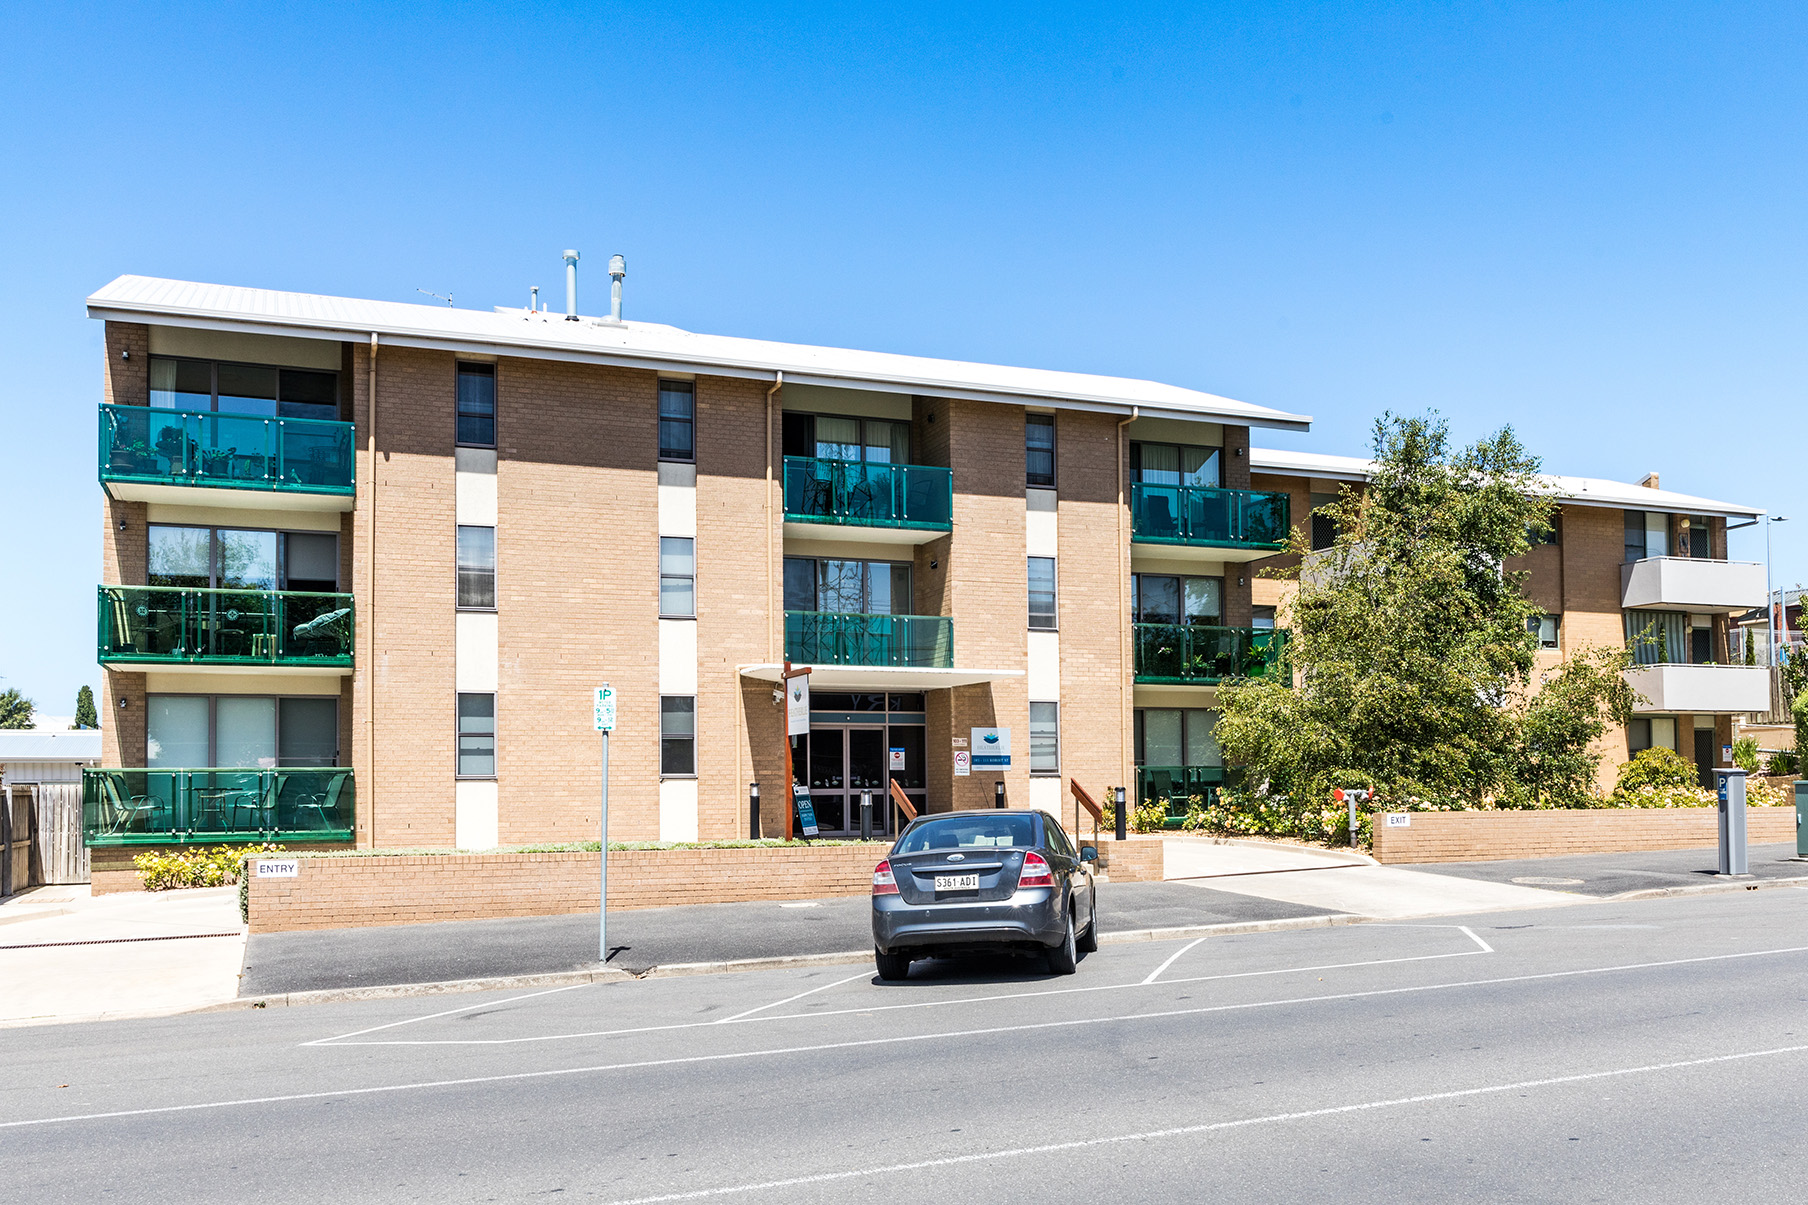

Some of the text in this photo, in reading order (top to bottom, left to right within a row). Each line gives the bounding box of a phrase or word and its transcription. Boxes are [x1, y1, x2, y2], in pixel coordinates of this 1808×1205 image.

[598, 690, 612, 700] 1P
[797, 800, 812, 809] OPEN
[1390, 816, 1406, 824] EXIT
[259, 864, 295, 874] ENTRY
